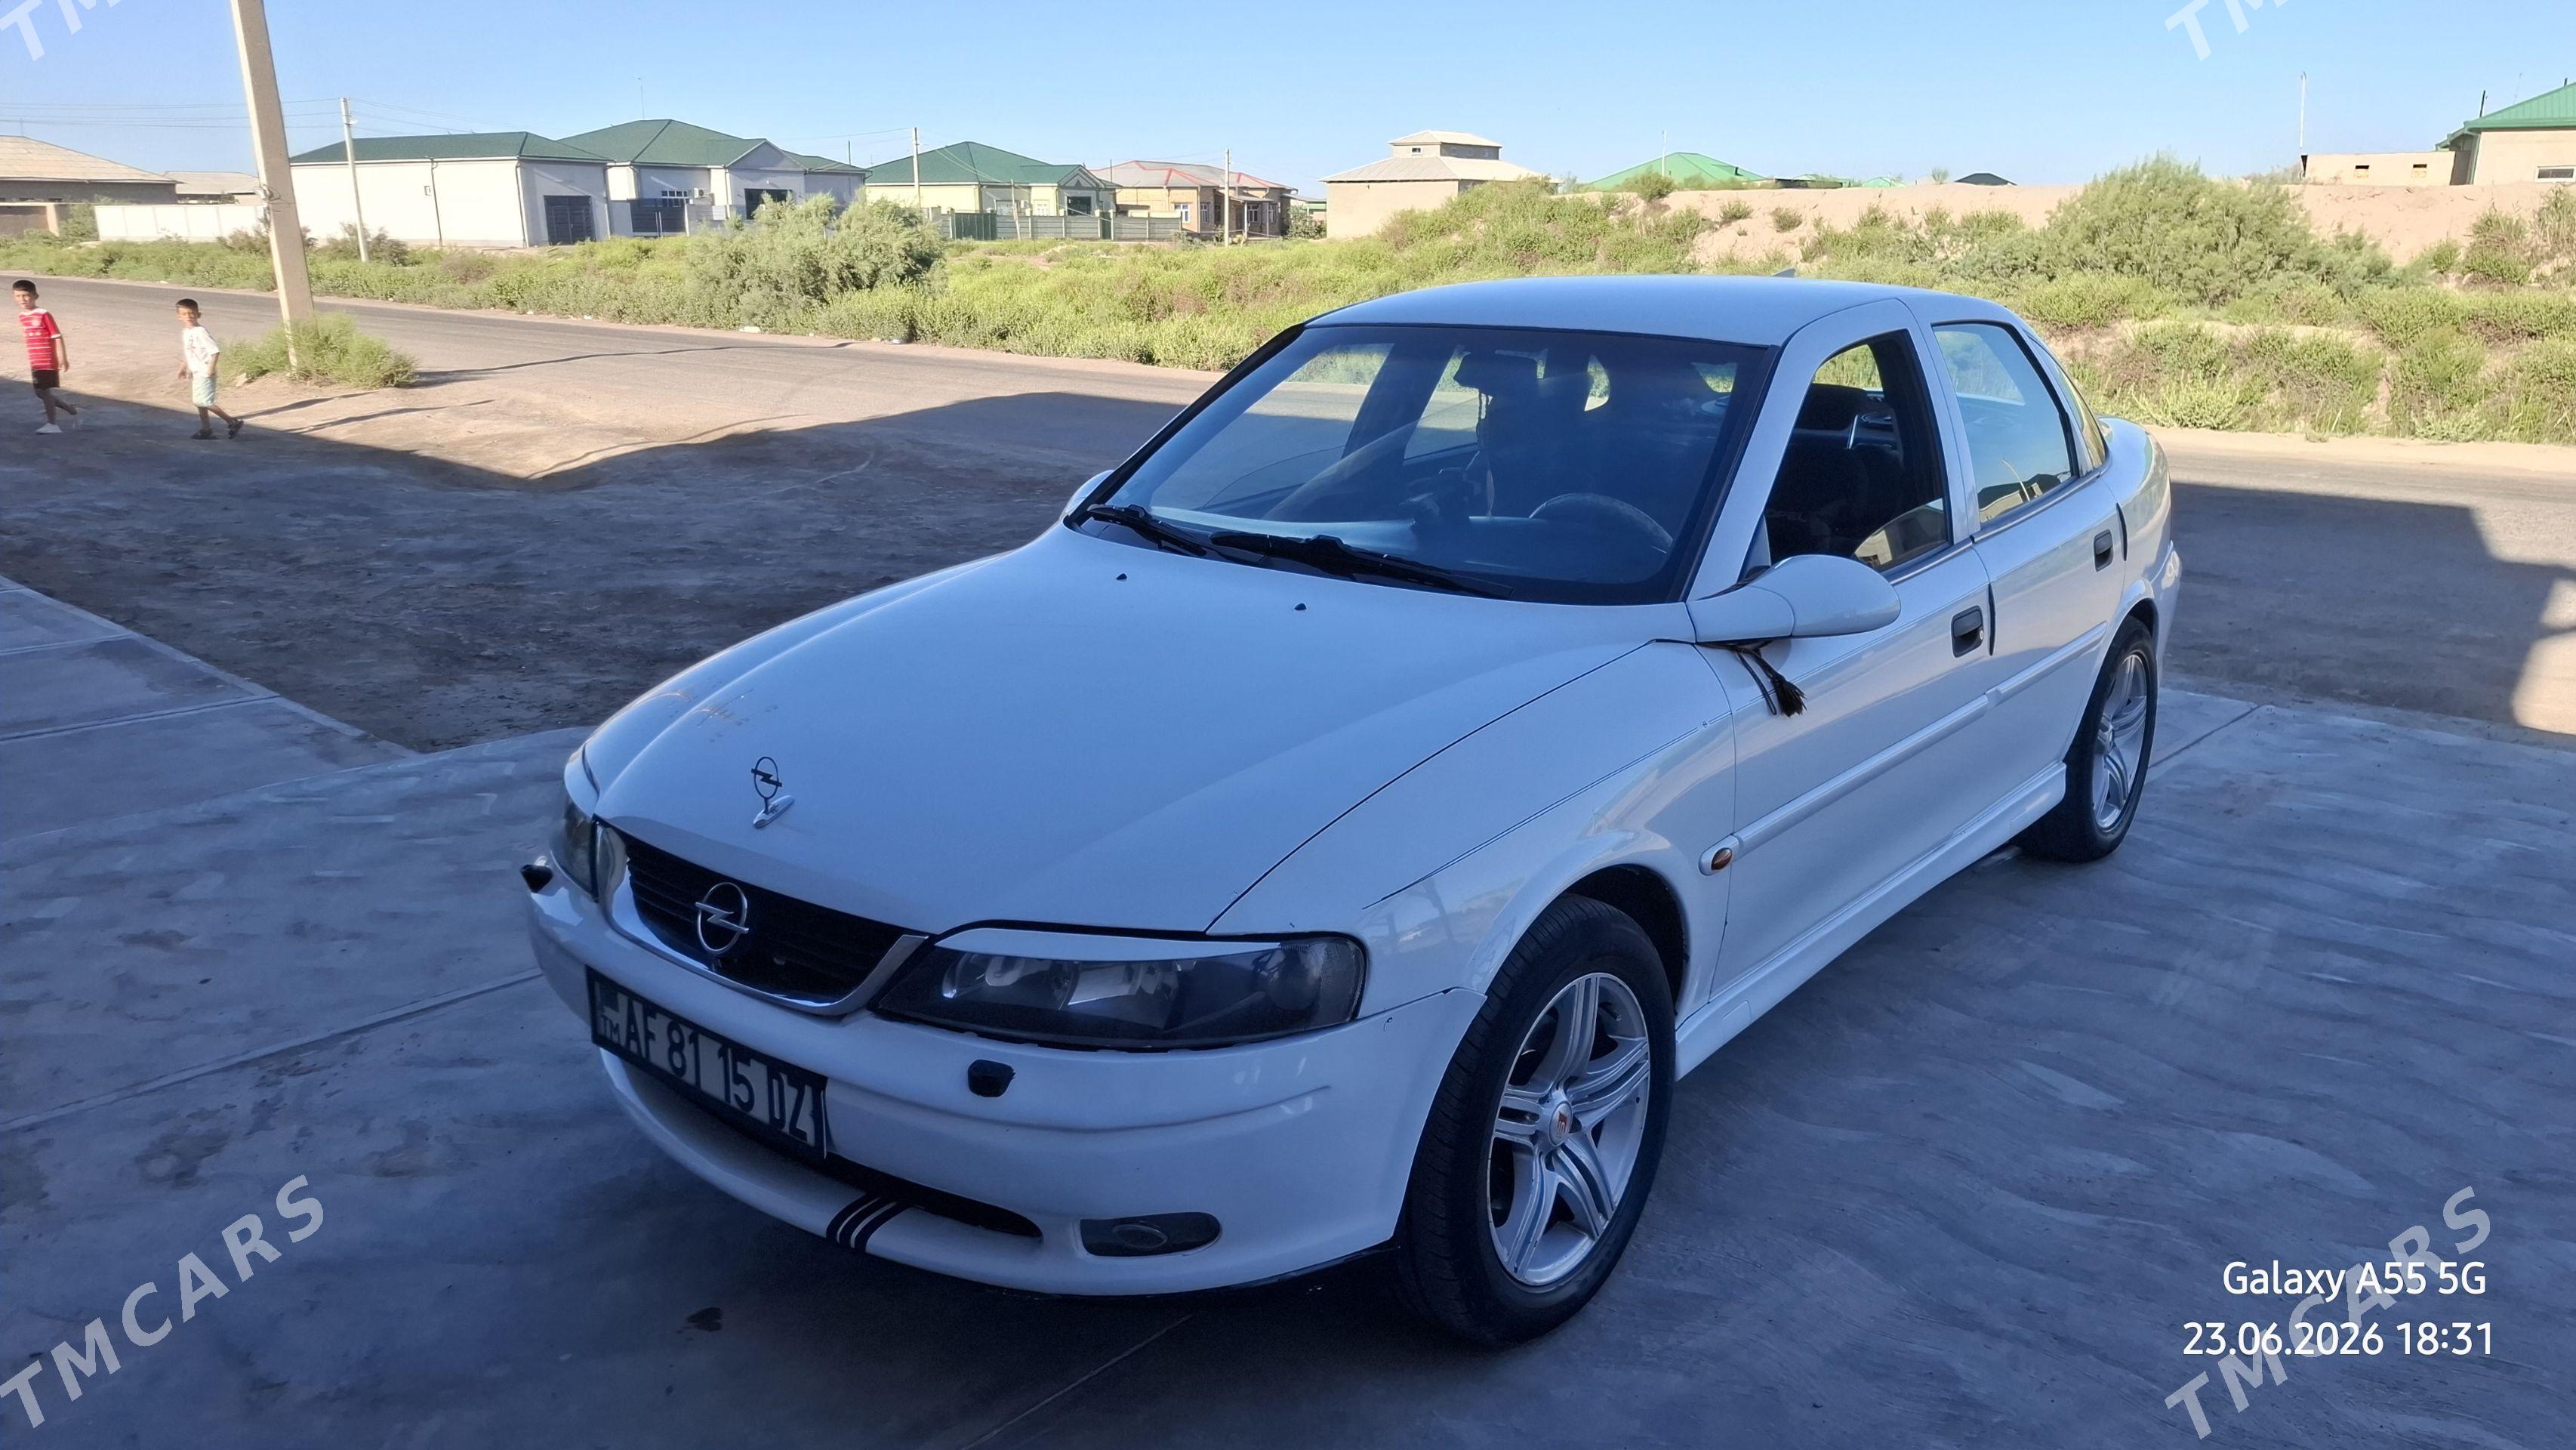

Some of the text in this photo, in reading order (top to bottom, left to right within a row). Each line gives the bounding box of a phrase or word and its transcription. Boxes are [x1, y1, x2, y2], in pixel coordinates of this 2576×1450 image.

[601, 1014, 621, 1044] TM
[625, 995, 809, 1143] AF 81 15 DZ
